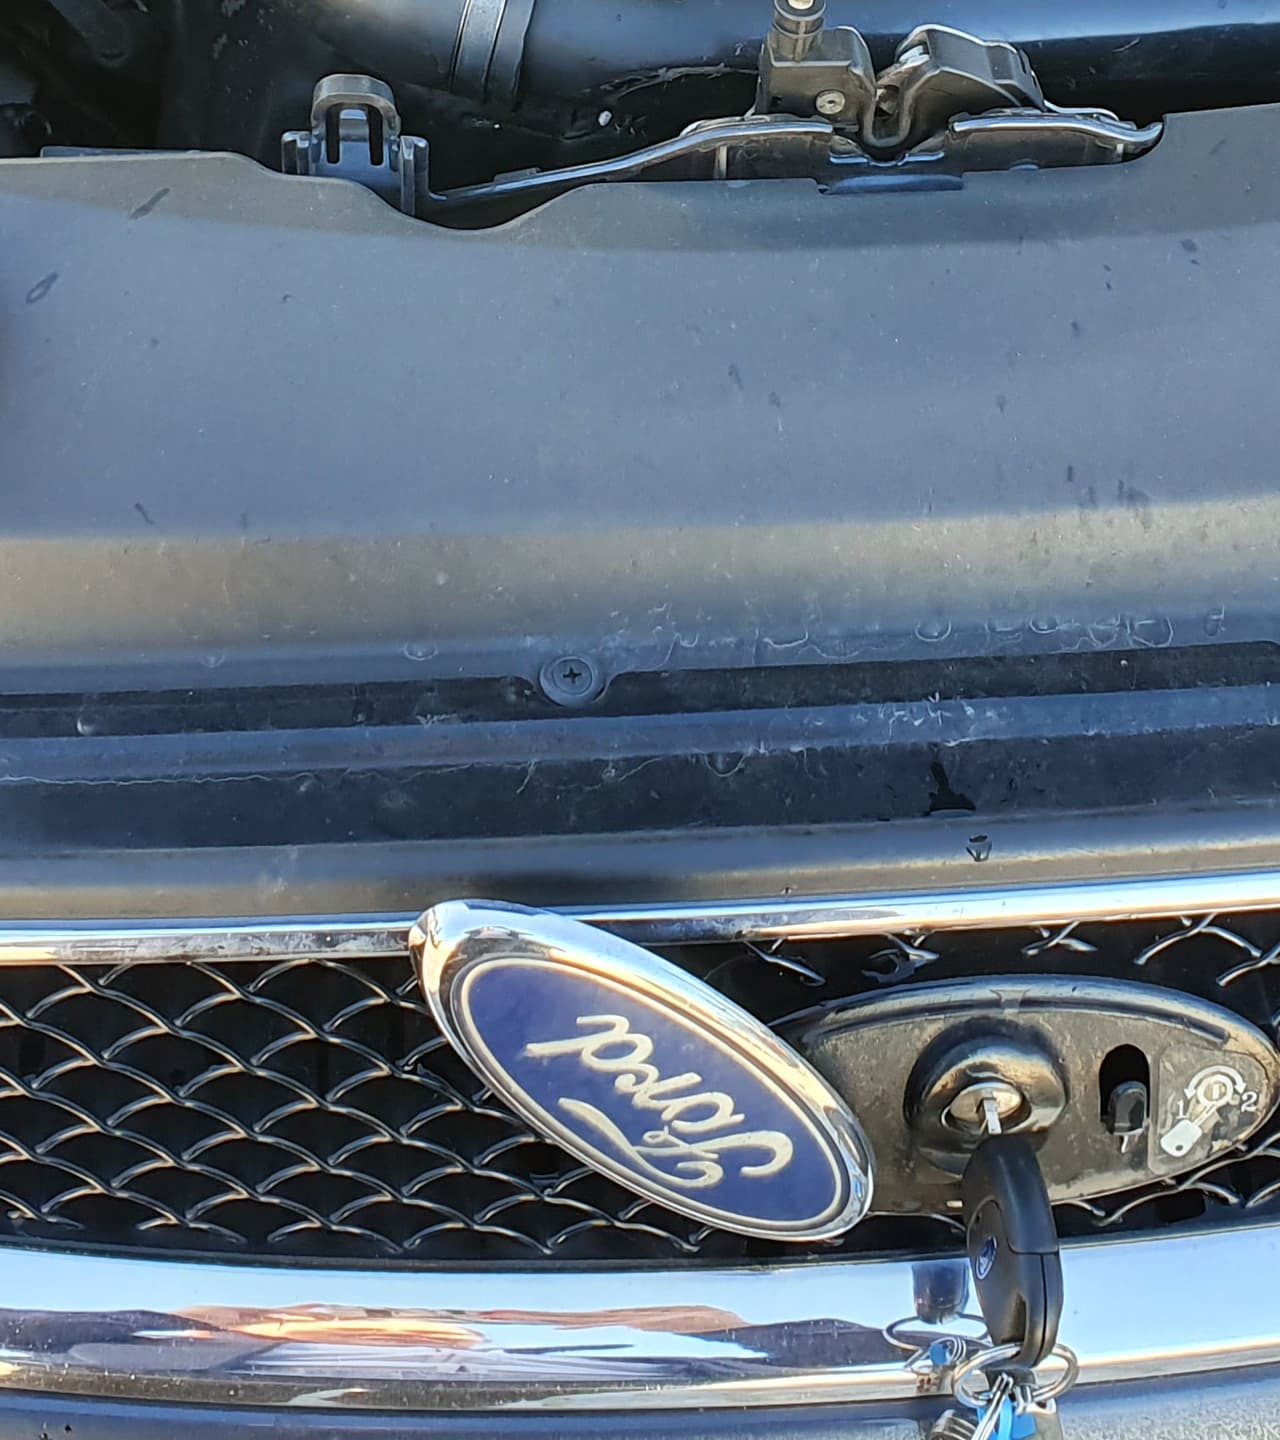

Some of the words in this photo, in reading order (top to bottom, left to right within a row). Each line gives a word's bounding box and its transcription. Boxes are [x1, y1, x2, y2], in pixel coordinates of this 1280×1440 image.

[524, 1011, 796, 1192] Ford
[1176, 1099, 1189, 1120] 1
[1241, 1092, 1258, 1112] 2
